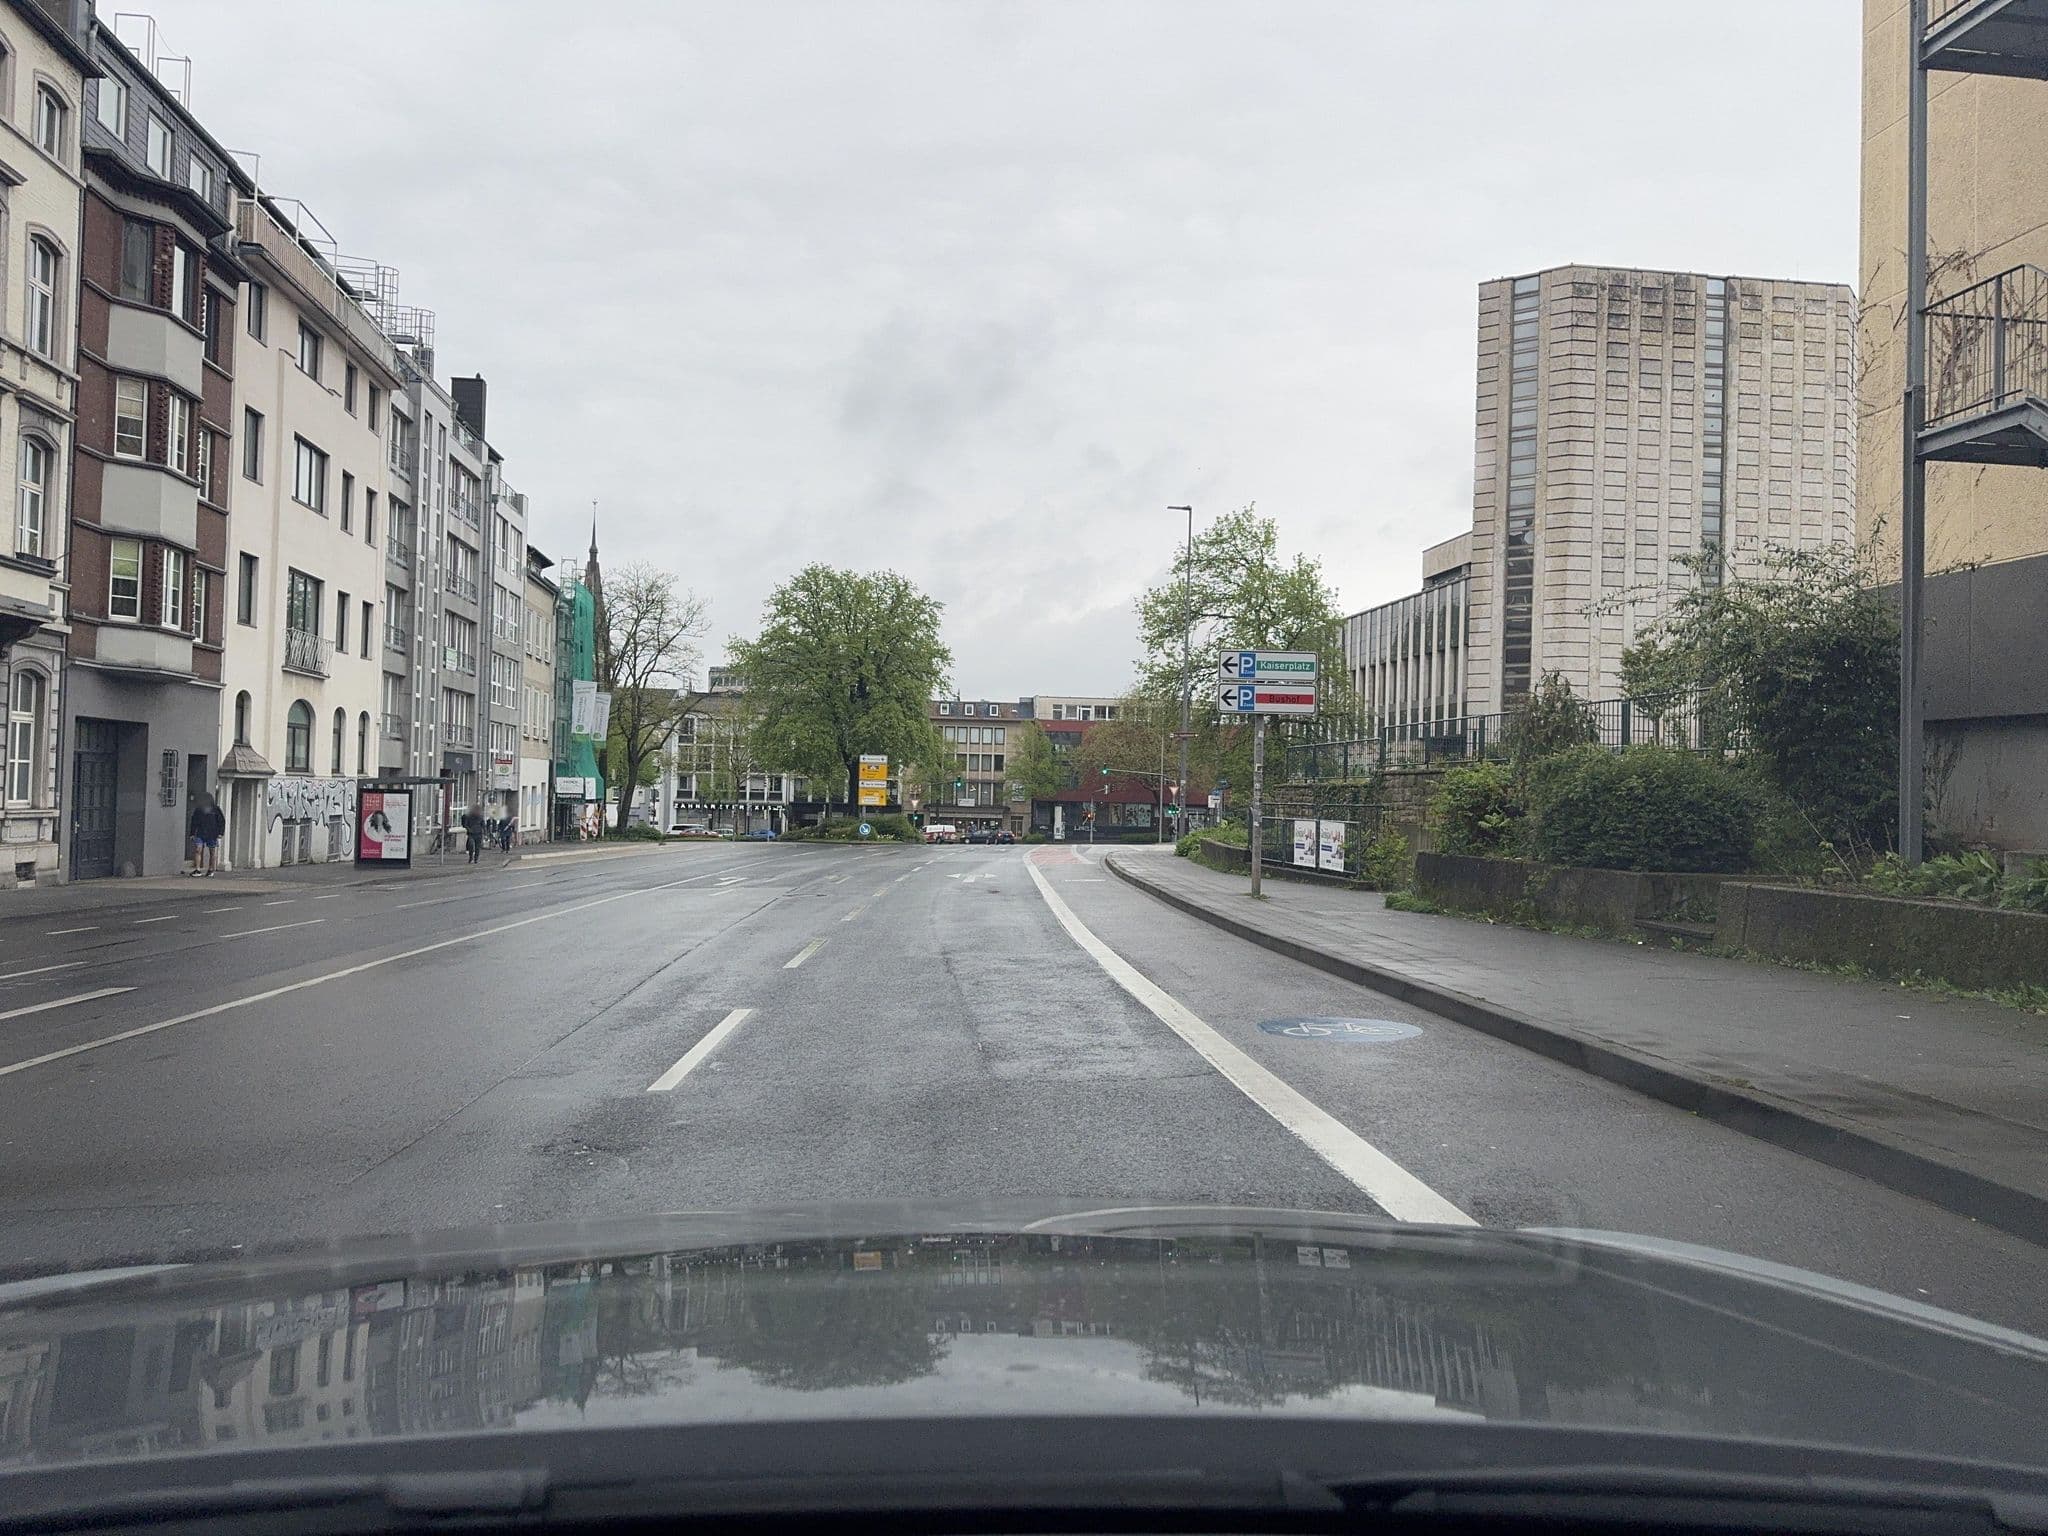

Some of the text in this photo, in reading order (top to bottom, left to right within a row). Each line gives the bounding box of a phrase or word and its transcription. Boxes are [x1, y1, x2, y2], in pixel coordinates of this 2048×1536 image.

[1241, 656, 1311, 674] P Kaiserplatz
[1240, 689, 1253, 707] P
